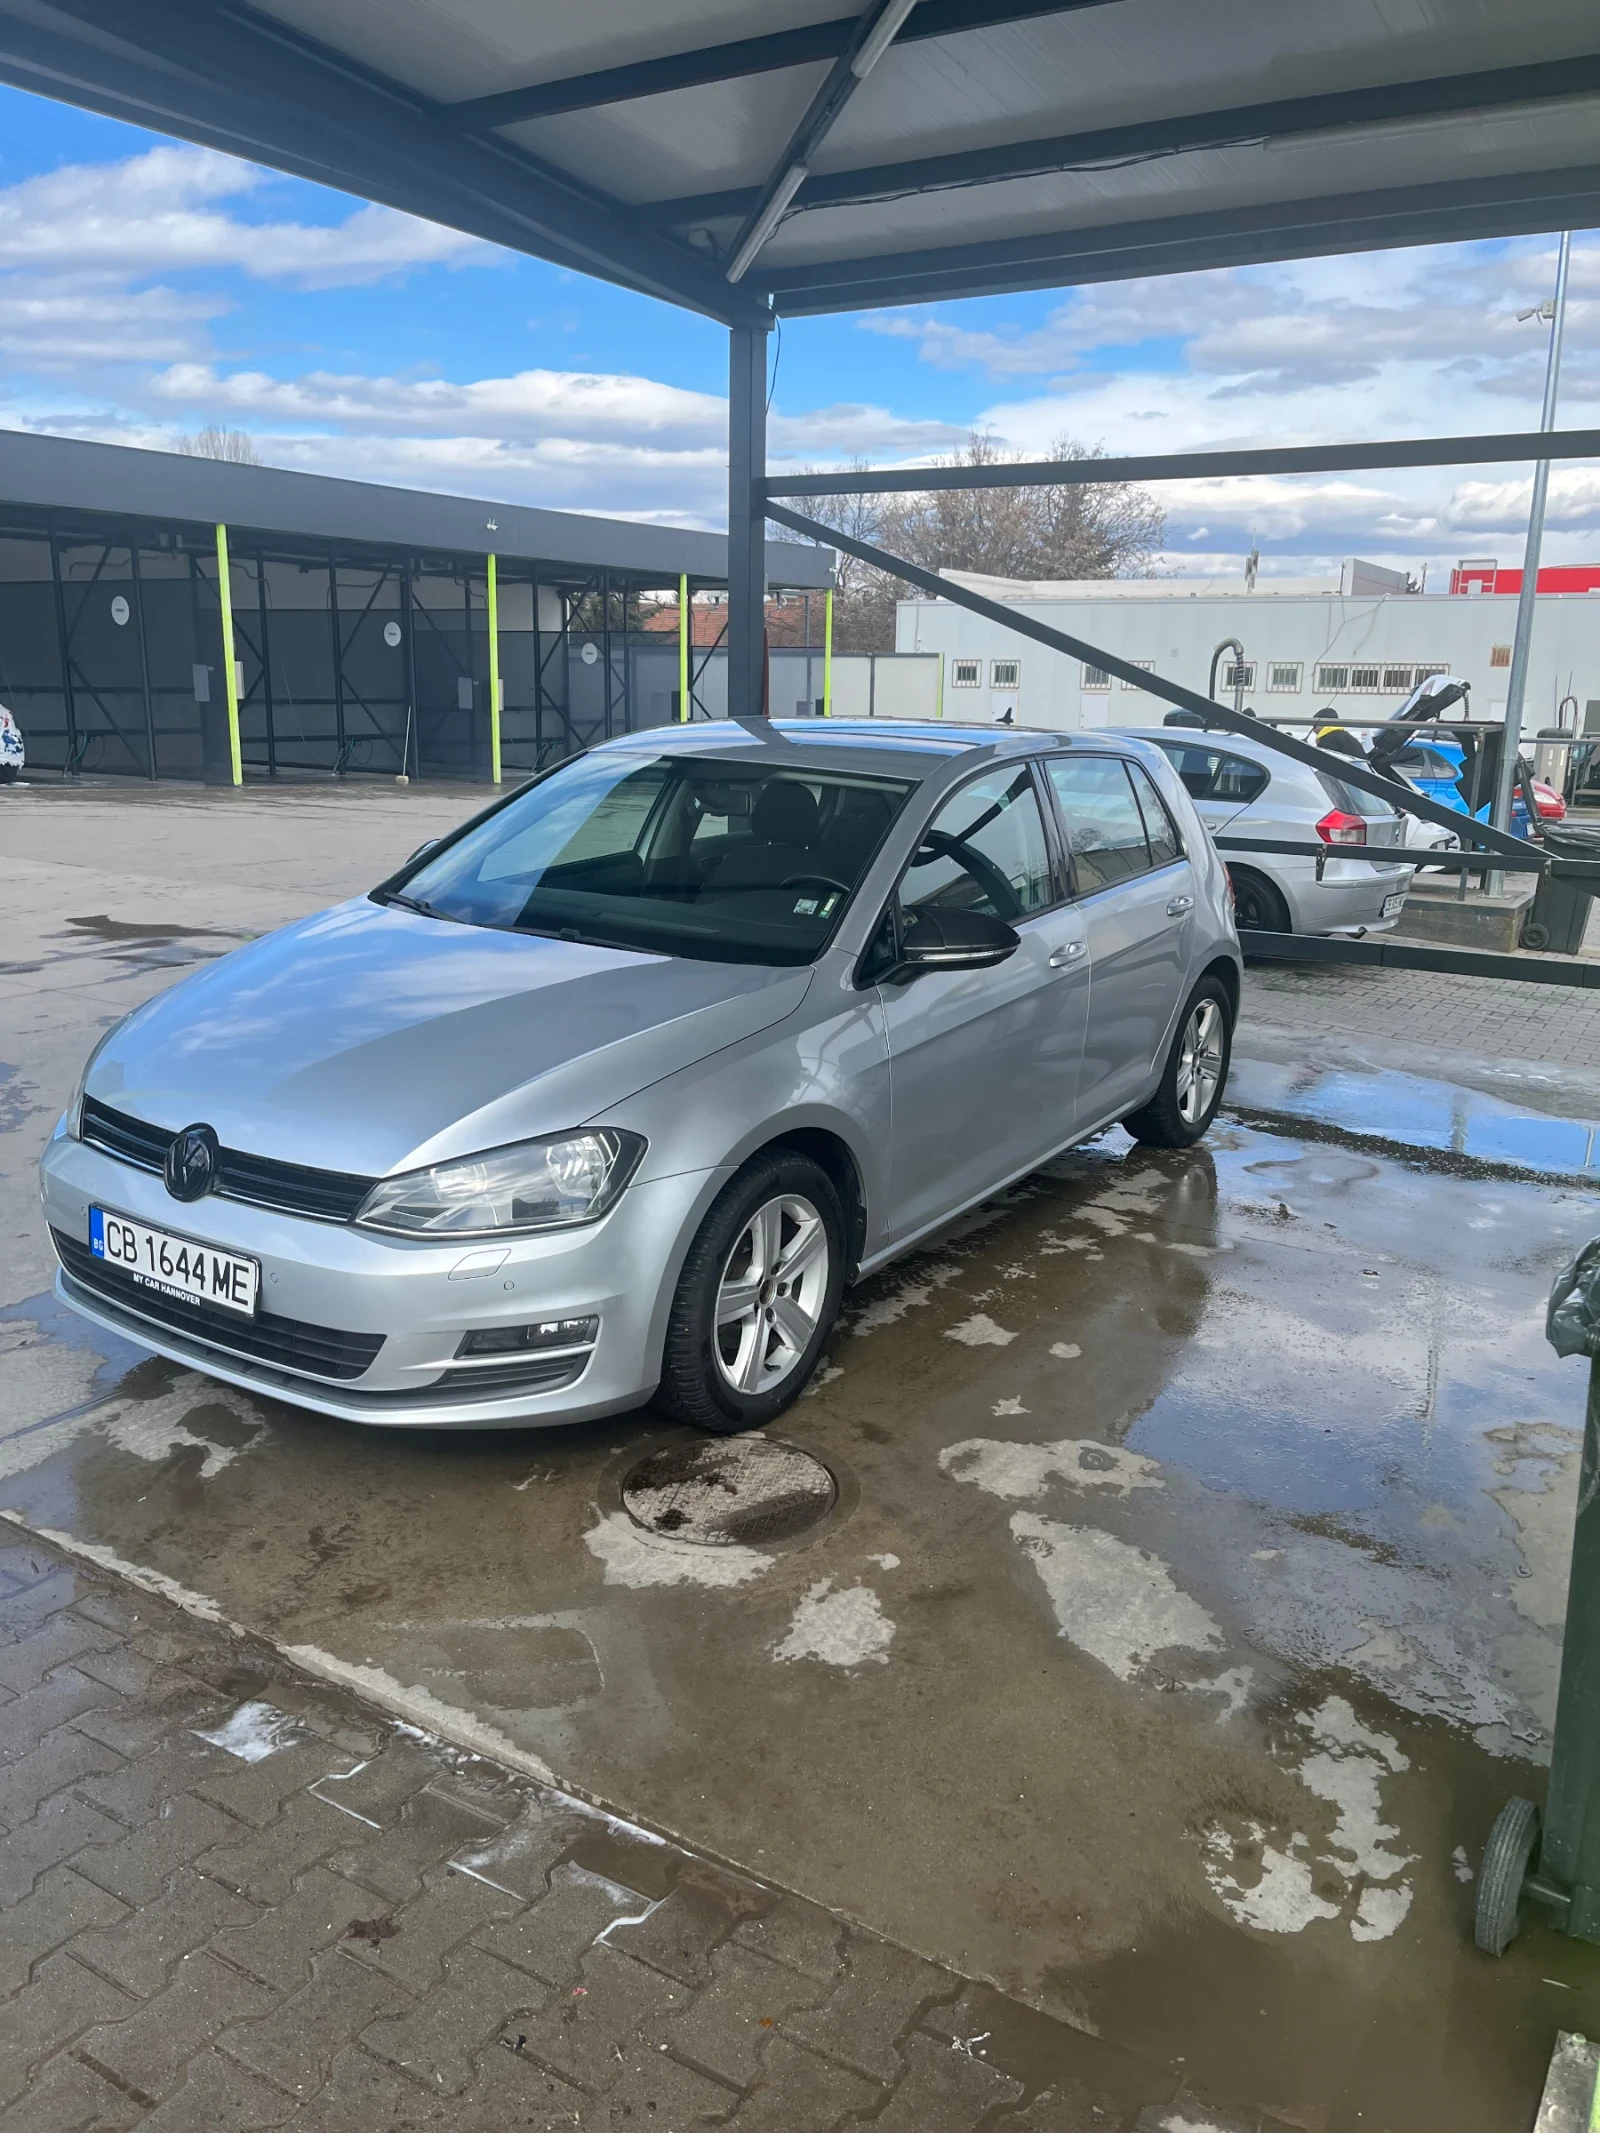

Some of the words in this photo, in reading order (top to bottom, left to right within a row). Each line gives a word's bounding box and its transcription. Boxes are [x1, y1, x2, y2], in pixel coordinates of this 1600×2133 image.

[93, 1237, 104, 1251] BG
[107, 1220, 138, 1263] CB
[145, 1235, 206, 1291] 1644
[212, 1256, 250, 1306] ME
[133, 1272, 144, 1284] MY
[144, 1276, 160, 1290] CAR
[161, 1284, 201, 1306] HANNOVER
